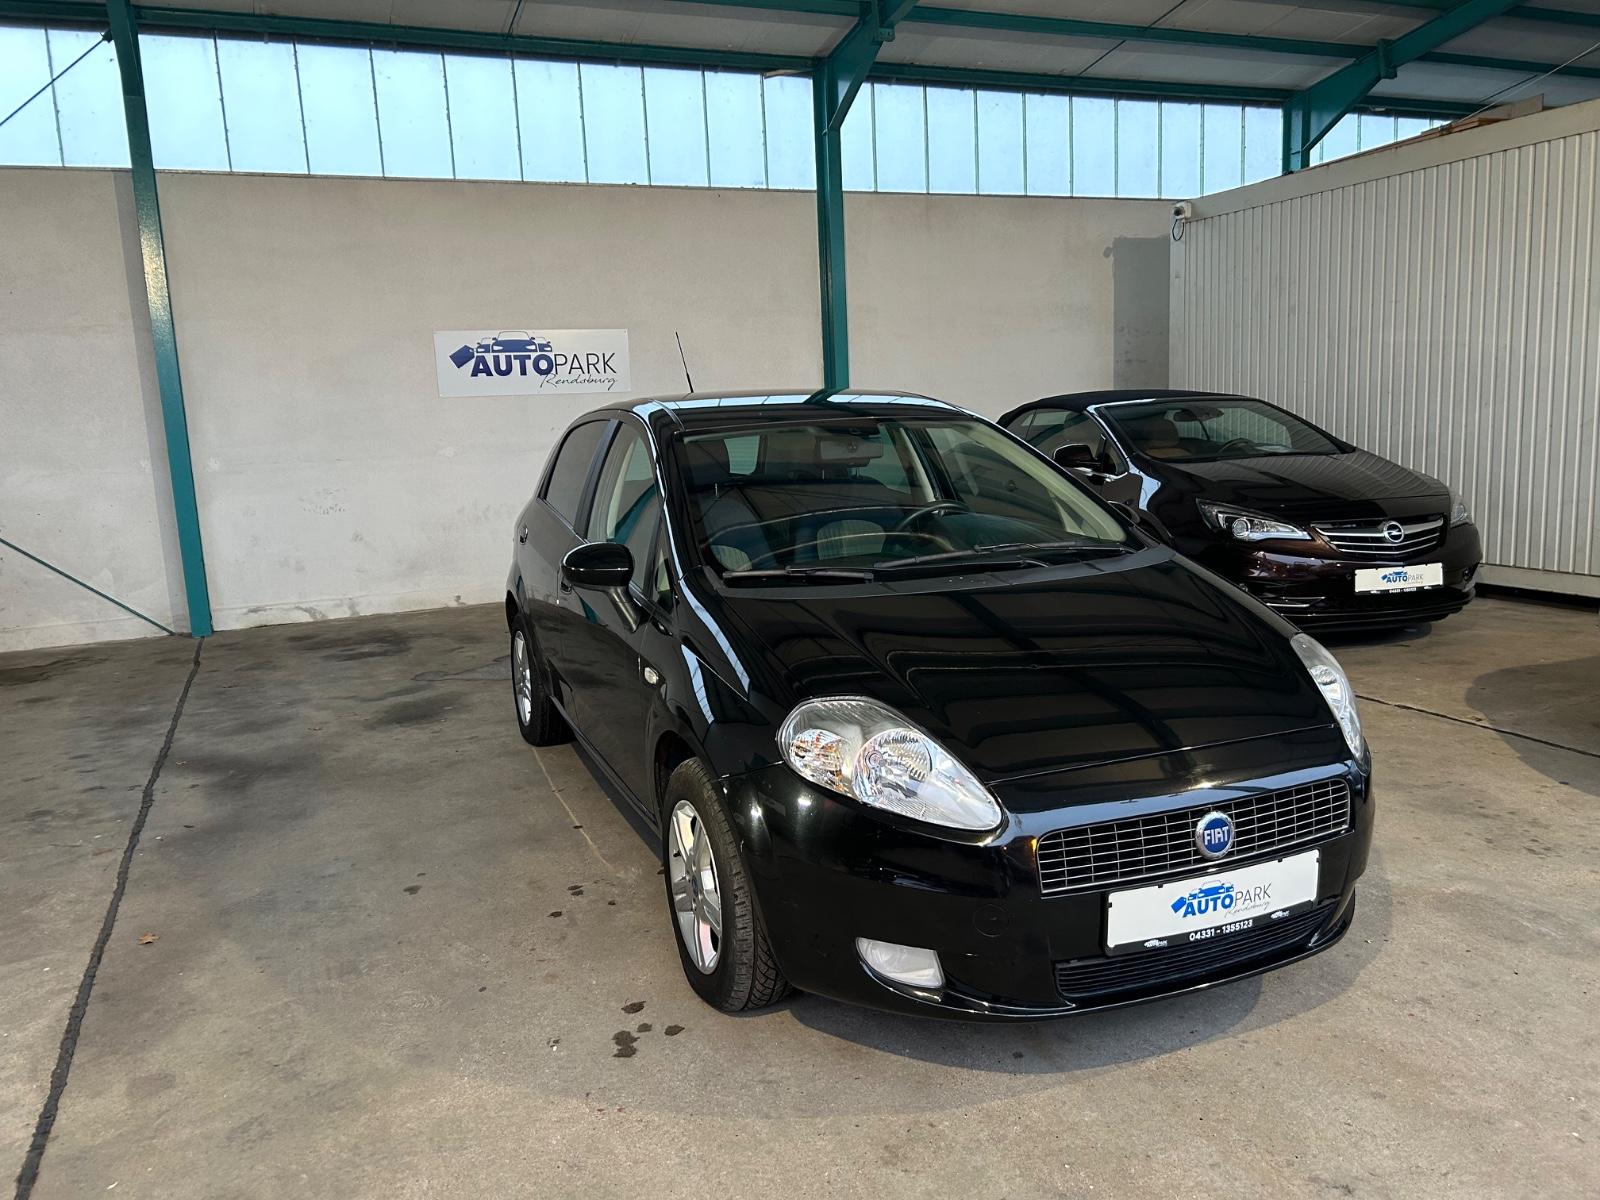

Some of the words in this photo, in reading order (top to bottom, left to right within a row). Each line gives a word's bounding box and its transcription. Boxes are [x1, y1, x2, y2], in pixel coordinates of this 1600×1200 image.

[540, 374, 617, 391] Rendsburg
[1203, 826, 1229, 845] FIAT
[1189, 930, 1215, 941] 04331
[1221, 919, 1253, 933] 1355123
